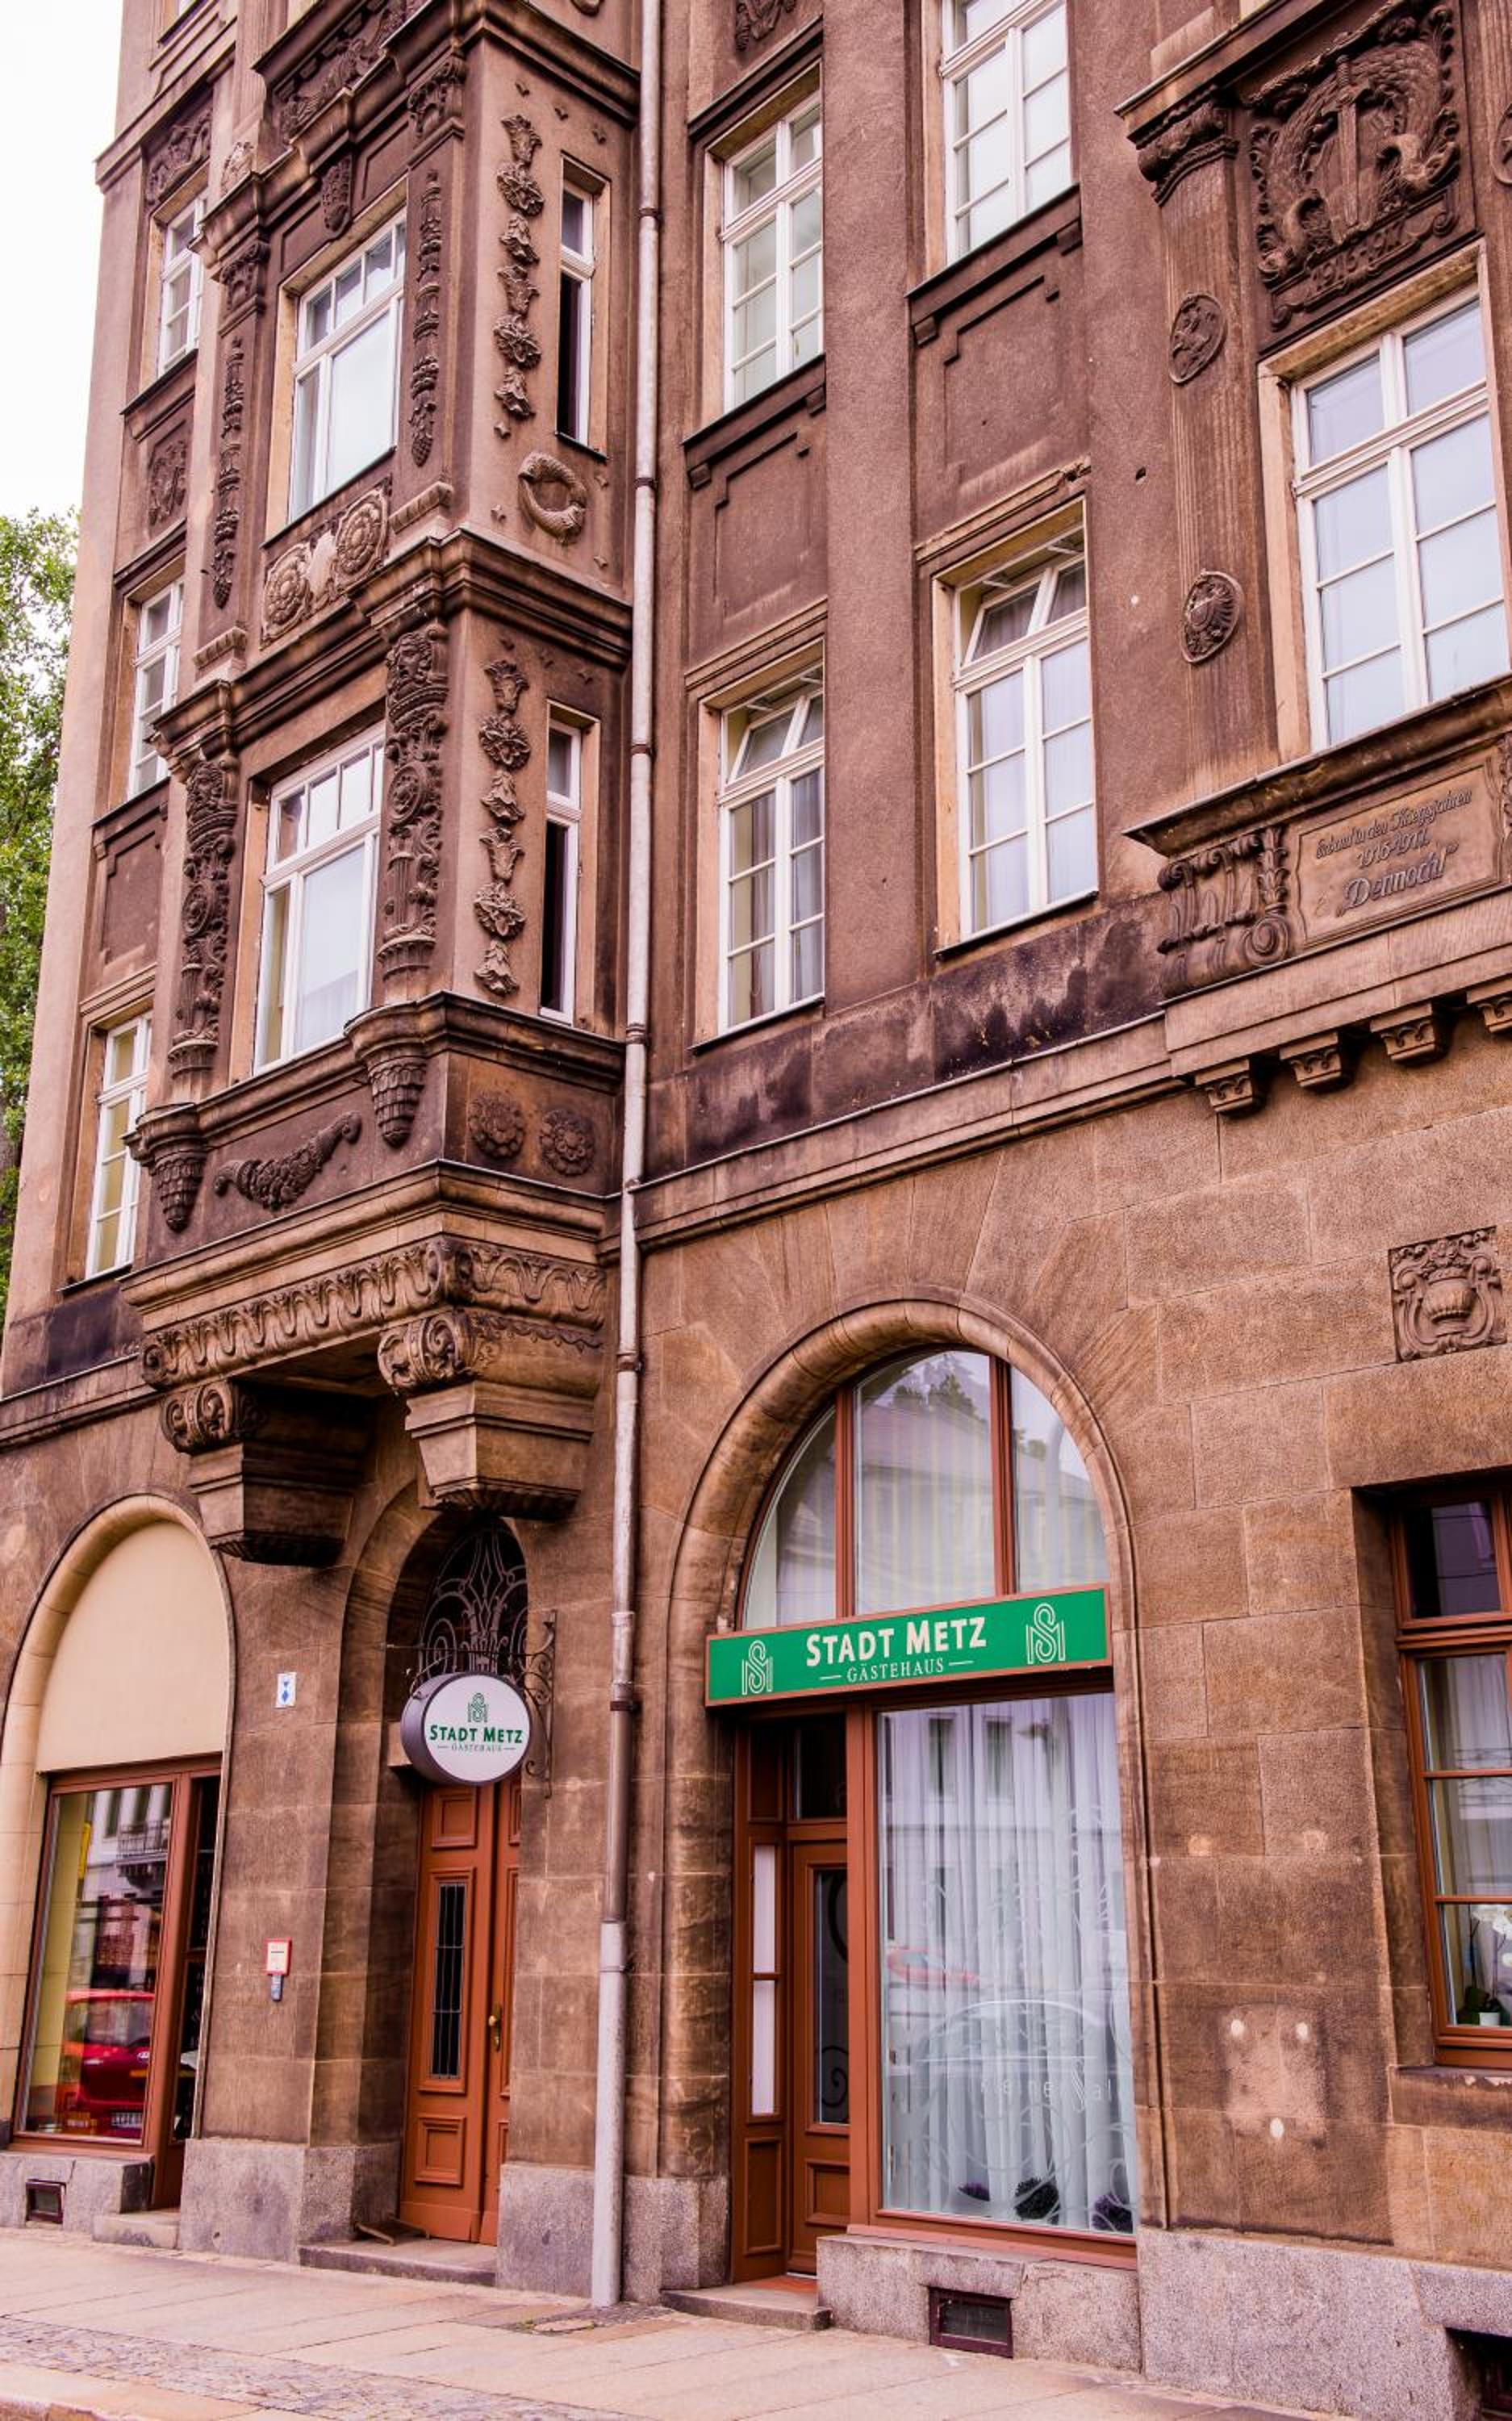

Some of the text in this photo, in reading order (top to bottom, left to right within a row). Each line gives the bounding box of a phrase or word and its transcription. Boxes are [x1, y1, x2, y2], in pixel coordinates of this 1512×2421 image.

[806, 1616, 987, 1667] STADT METZ
[846, 1658, 945, 1684] GÄSTEHAUS
[429, 1725, 524, 1744] STADT METZ
